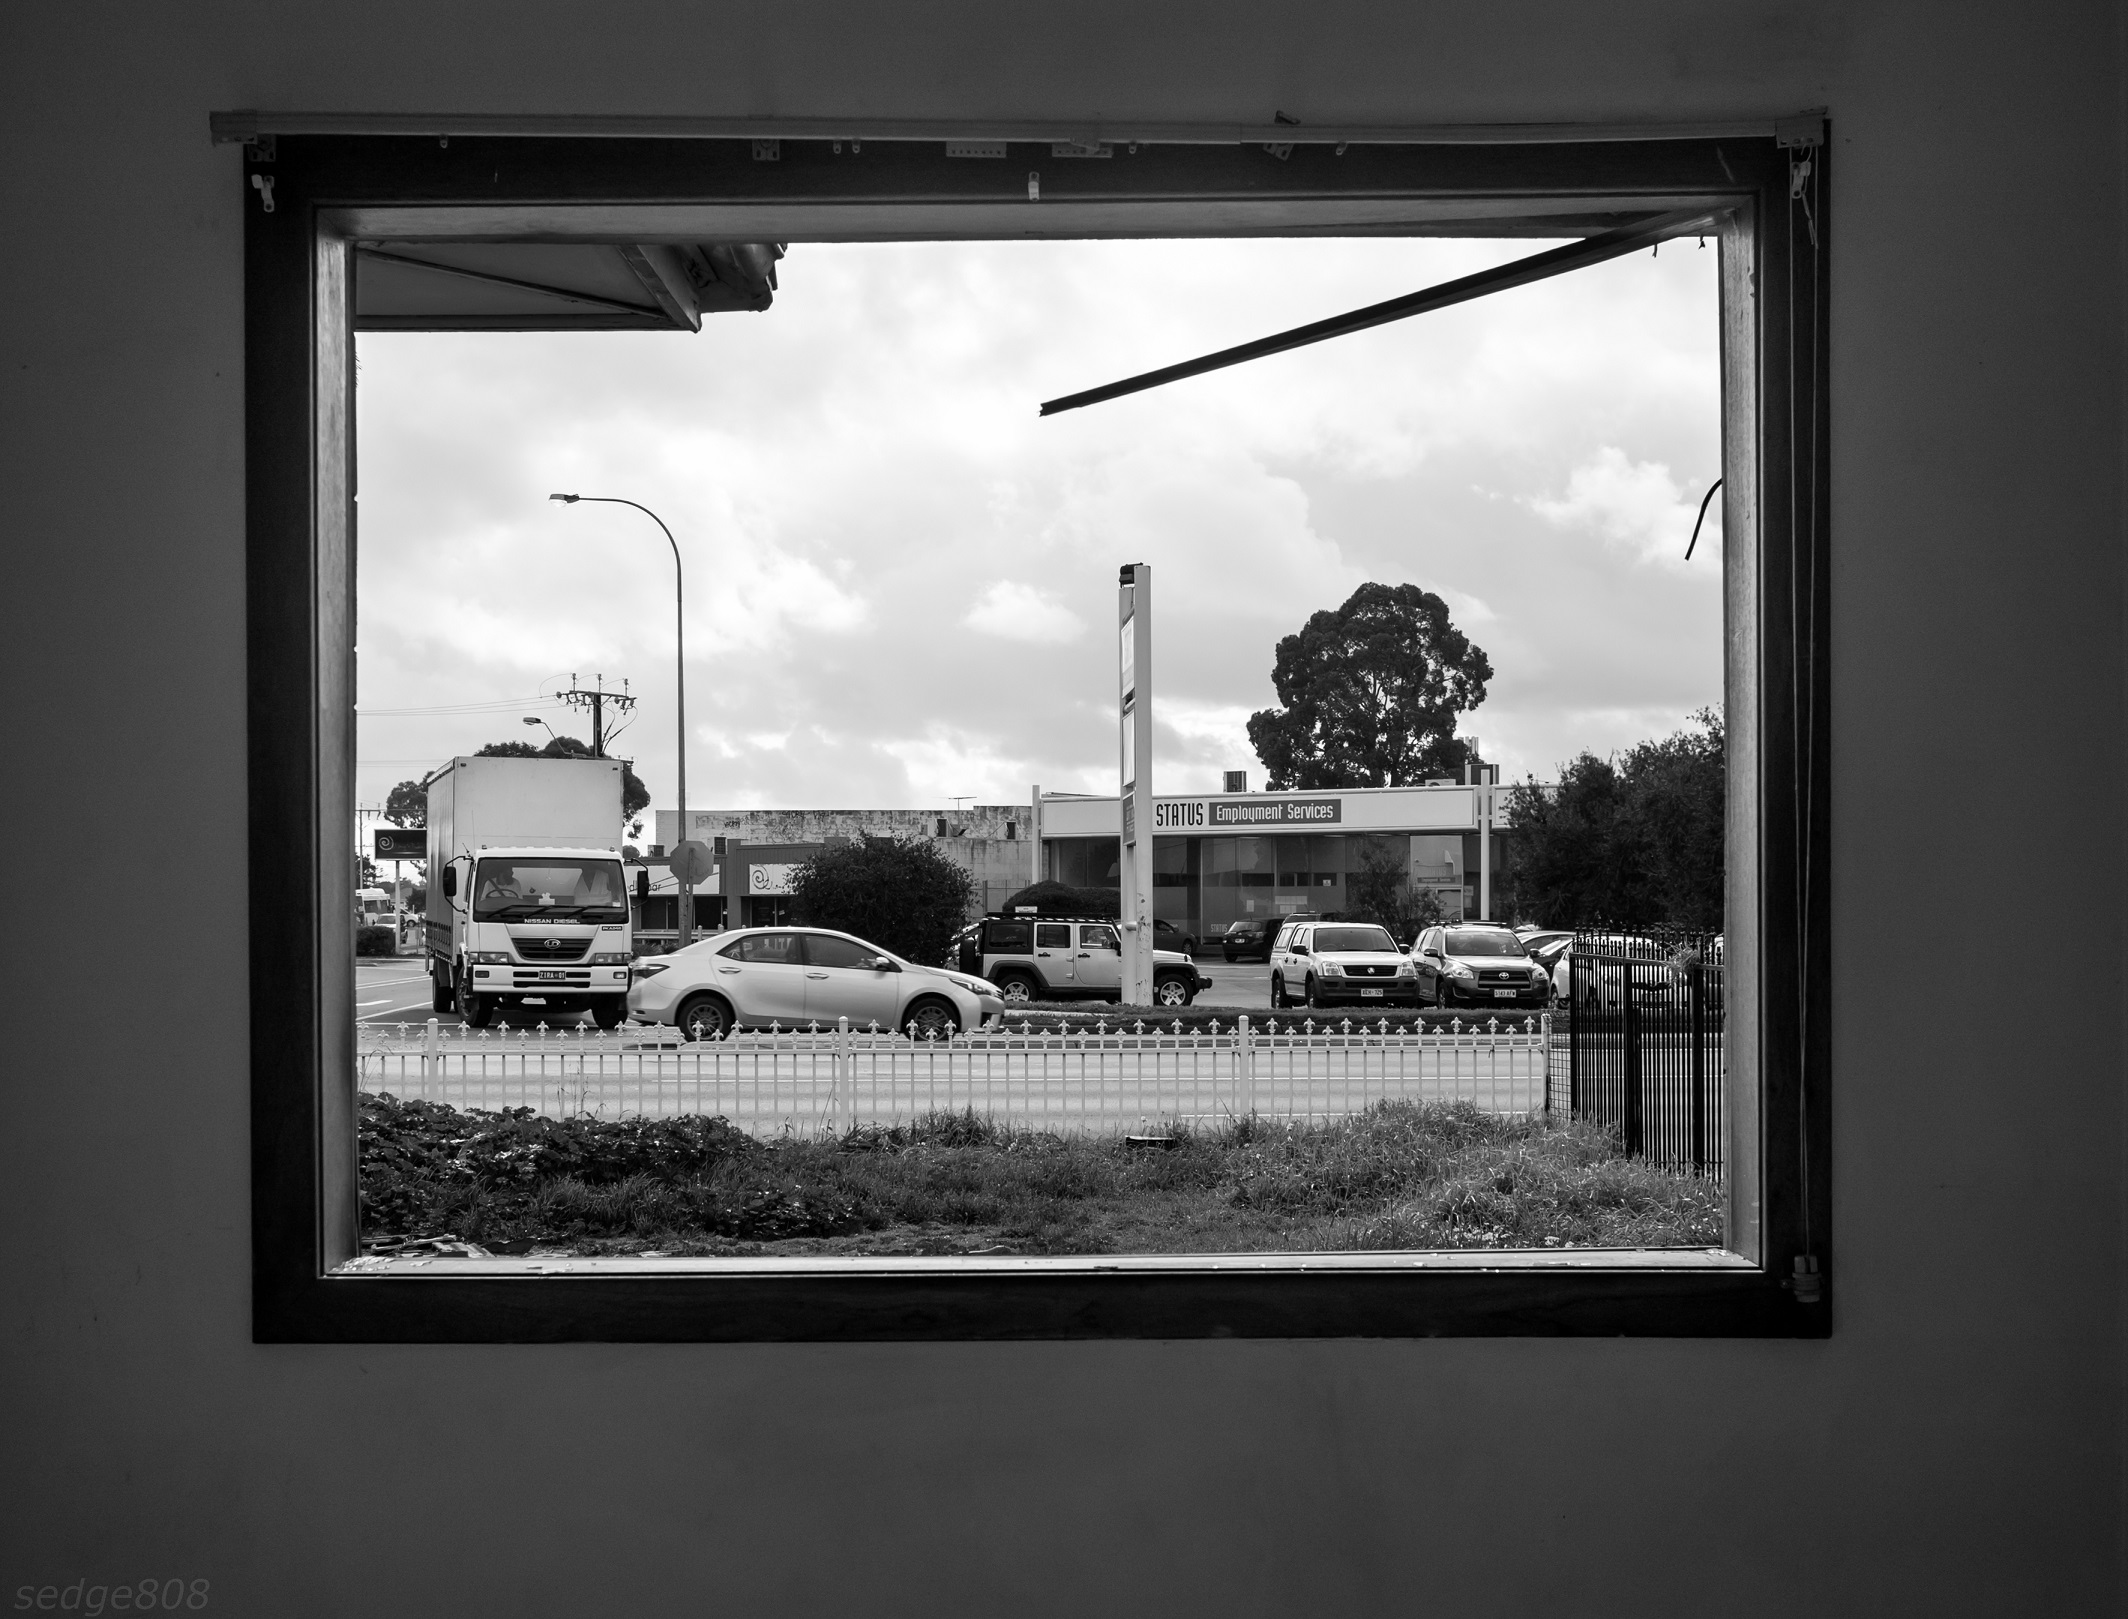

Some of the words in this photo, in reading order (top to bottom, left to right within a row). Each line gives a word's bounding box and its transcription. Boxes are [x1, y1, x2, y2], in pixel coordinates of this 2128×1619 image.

[1156, 803, 1203, 826] STATUS
[1216, 803, 1283, 823] Employment
[1287, 802, 1334, 819] Services
